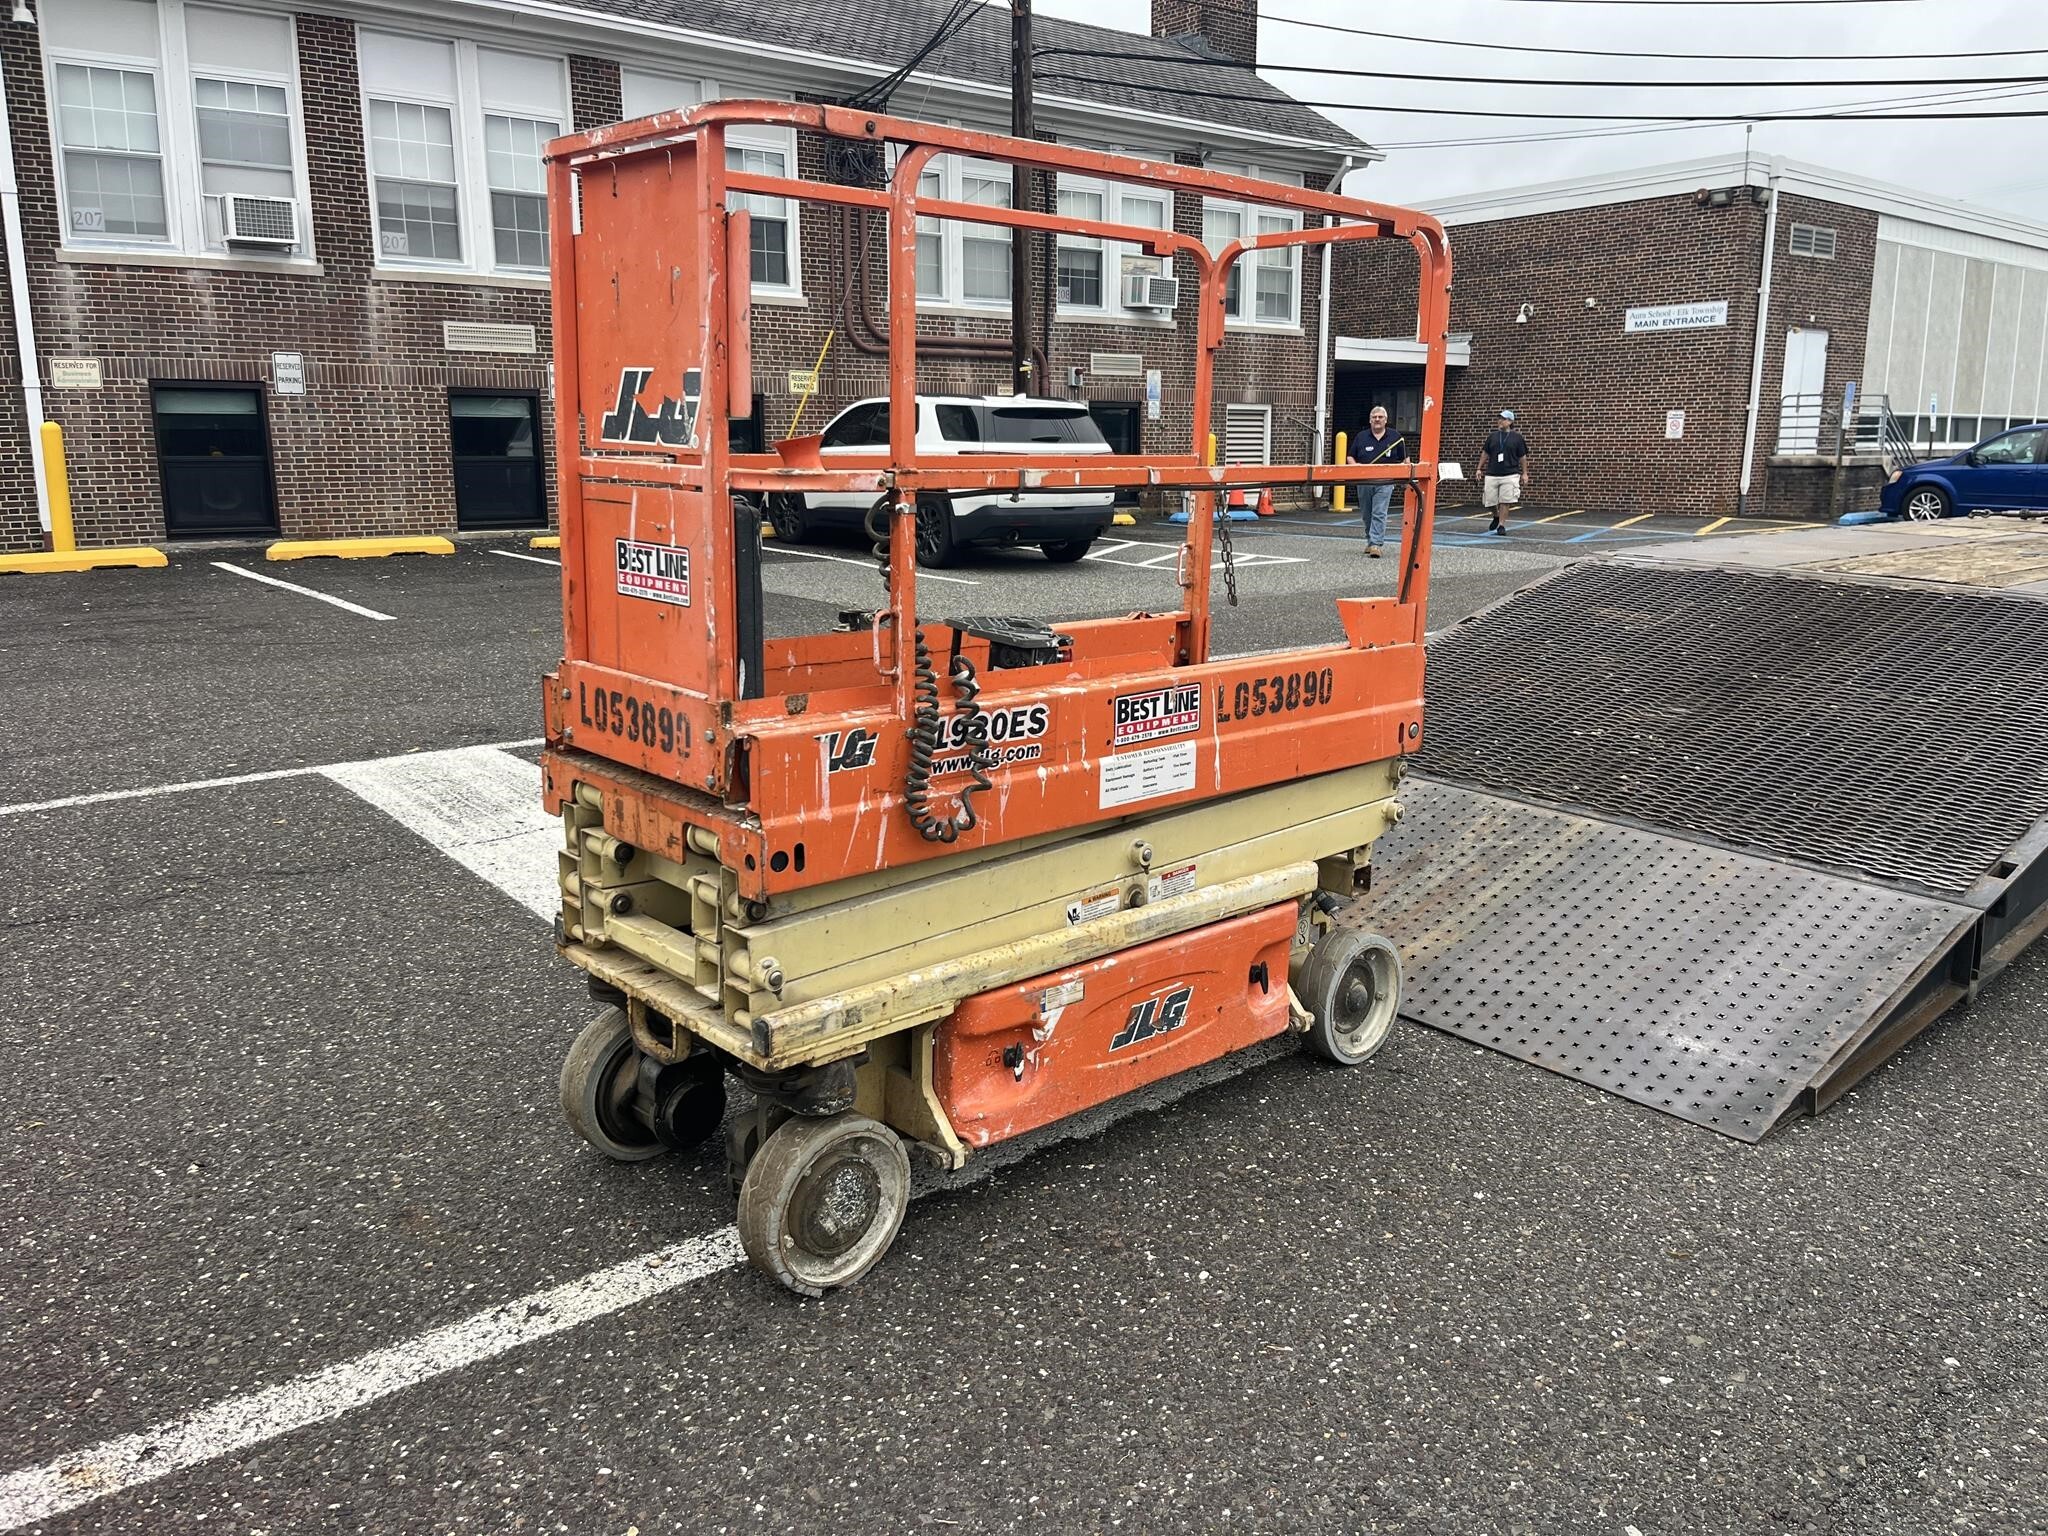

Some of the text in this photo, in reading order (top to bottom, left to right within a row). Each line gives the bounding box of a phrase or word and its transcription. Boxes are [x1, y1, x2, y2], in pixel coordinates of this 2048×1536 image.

[74, 211, 103, 226] 207
[382, 235, 407, 250] 207
[1648, 309, 1671, 319] School
[1677, 308, 1689, 317] Elk
[1692, 305, 1724, 316] Township
[1634, 315, 1717, 329] MAIN ENTRANCE
[276, 362, 301, 371] RESERVED
[278, 376, 302, 385] PARKING
[617, 541, 689, 581] BEST LINE
[619, 573, 689, 595] EQUIPMENT
[1216, 667, 1334, 724] L053890
[1117, 689, 1199, 725] BEST LINE
[579, 680, 692, 760] L053890
[1118, 713, 1198, 736] EQUIPMENT
[1114, 751, 1143, 761] USTOMER
[1108, 984, 1195, 1053] JLG
